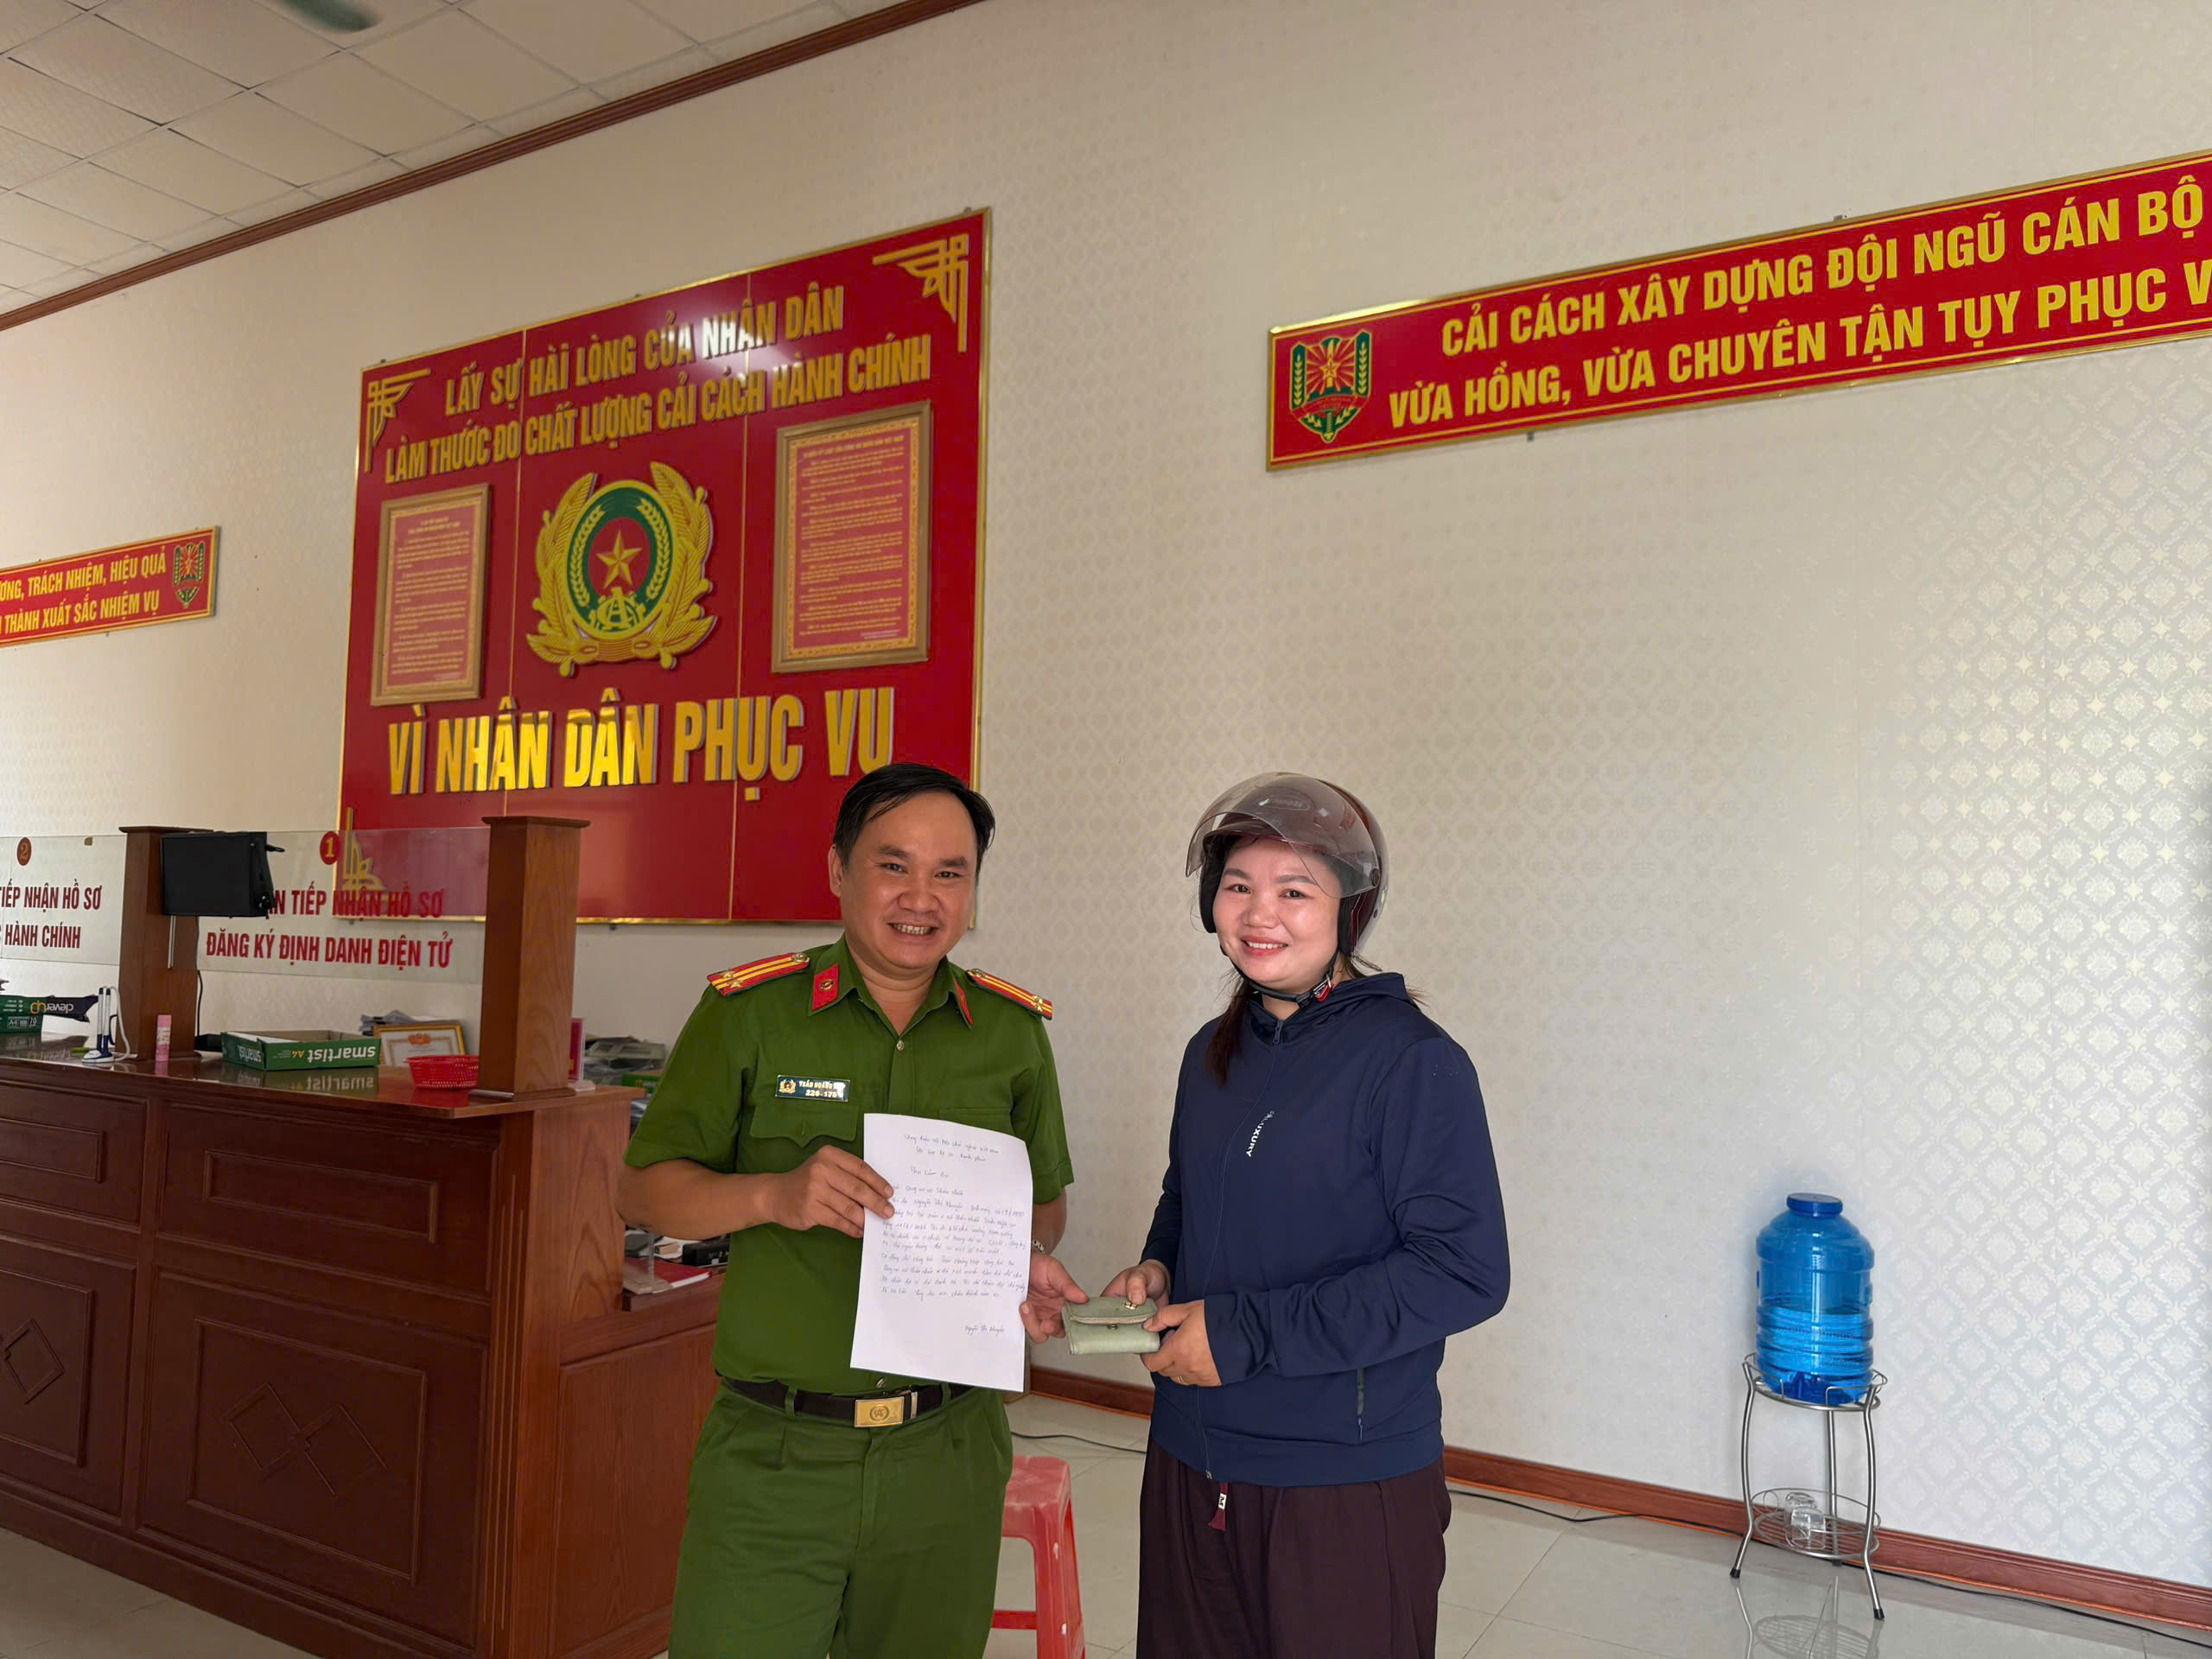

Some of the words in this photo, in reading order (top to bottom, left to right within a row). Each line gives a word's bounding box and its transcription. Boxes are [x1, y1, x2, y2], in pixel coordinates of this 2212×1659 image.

[1442, 302, 1498, 356] CẢI
[1510, 292, 1605, 344] CÁCH
[1618, 272, 1690, 326] XÂY
[1703, 254, 1814, 314] DỰNG
[1827, 232, 1897, 292] ĐỘI
[1914, 211, 2005, 275] NGŨ
[2023, 196, 2120, 256] CÁN
[2138, 175, 2203, 239] BỘ
[445, 360, 485, 416] LẤY
[491, 357, 524, 410] SỰ
[529, 342, 569, 397] HÀI
[575, 334, 637, 386] LÒNG
[644, 310, 696, 371] CỦA
[702, 297, 776, 359] NHÂN
[785, 281, 844, 340] DÂN
[1389, 380, 1453, 429] VỪA
[1465, 359, 1571, 416] HỒNG,
[1583, 346, 1656, 397] VỪA
[1669, 318, 1826, 383] CHUYÊN
[1839, 303, 1923, 363] TẬN
[1938, 289, 2021, 348] TỤY
[2037, 268, 2166, 329] PHỤC
[2183, 259, 2212, 305] V
[385, 435, 429, 485] LÀM
[430, 419, 493, 475] THƯỚC
[493, 420, 523, 463] ĐO
[524, 400, 578, 456] CHẤT
[581, 392, 653, 449] LƯỢNG
[657, 371, 696, 429] CẢI
[701, 365, 766, 422] CÁCH
[771, 353, 843, 410] HÀNH
[848, 333, 931, 393] CHÍNH
[28, 569, 63, 598] TRÁCH
[110, 554, 138, 585] HIỆU
[141, 545, 167, 578] QUẢ
[4, 607, 41, 634] THÀNH
[42, 597, 72, 629] XUẤT
[73, 593, 98, 624] SẮC
[100, 589, 140, 620] NHIỆM
[143, 589, 160, 616] VỤ
[388, 703, 428, 795] VÌ
[435, 696, 553, 792] NHÂN
[563, 687, 659, 788] DÂN
[672, 694, 804, 801] PHỤC
[20, 842, 29, 861] 2
[325, 837, 335, 858] 1
[0, 878, 21, 908] IẾP
[24, 882, 59, 912] NHẬN
[62, 879, 80, 910] HỒ
[83, 885, 102, 910] SƠ
[291, 880, 327, 915] TIẾP
[332, 886, 382, 922] NHẬN
[387, 880, 410, 918] HỒ
[418, 887, 445, 918] SƠ
[4, 920, 38, 946] HÀNH
[41, 921, 81, 949] CHÍNH
[206, 928, 250, 958] ĐĂNG
[253, 928, 275, 959] KÝ
[279, 934, 320, 965] ĐỊNH
[325, 937, 372, 964] DANH
[378, 934, 422, 970] ĐIỆN
[428, 931, 454, 968] TỬ
[307, 1046, 376, 1063] smartist
